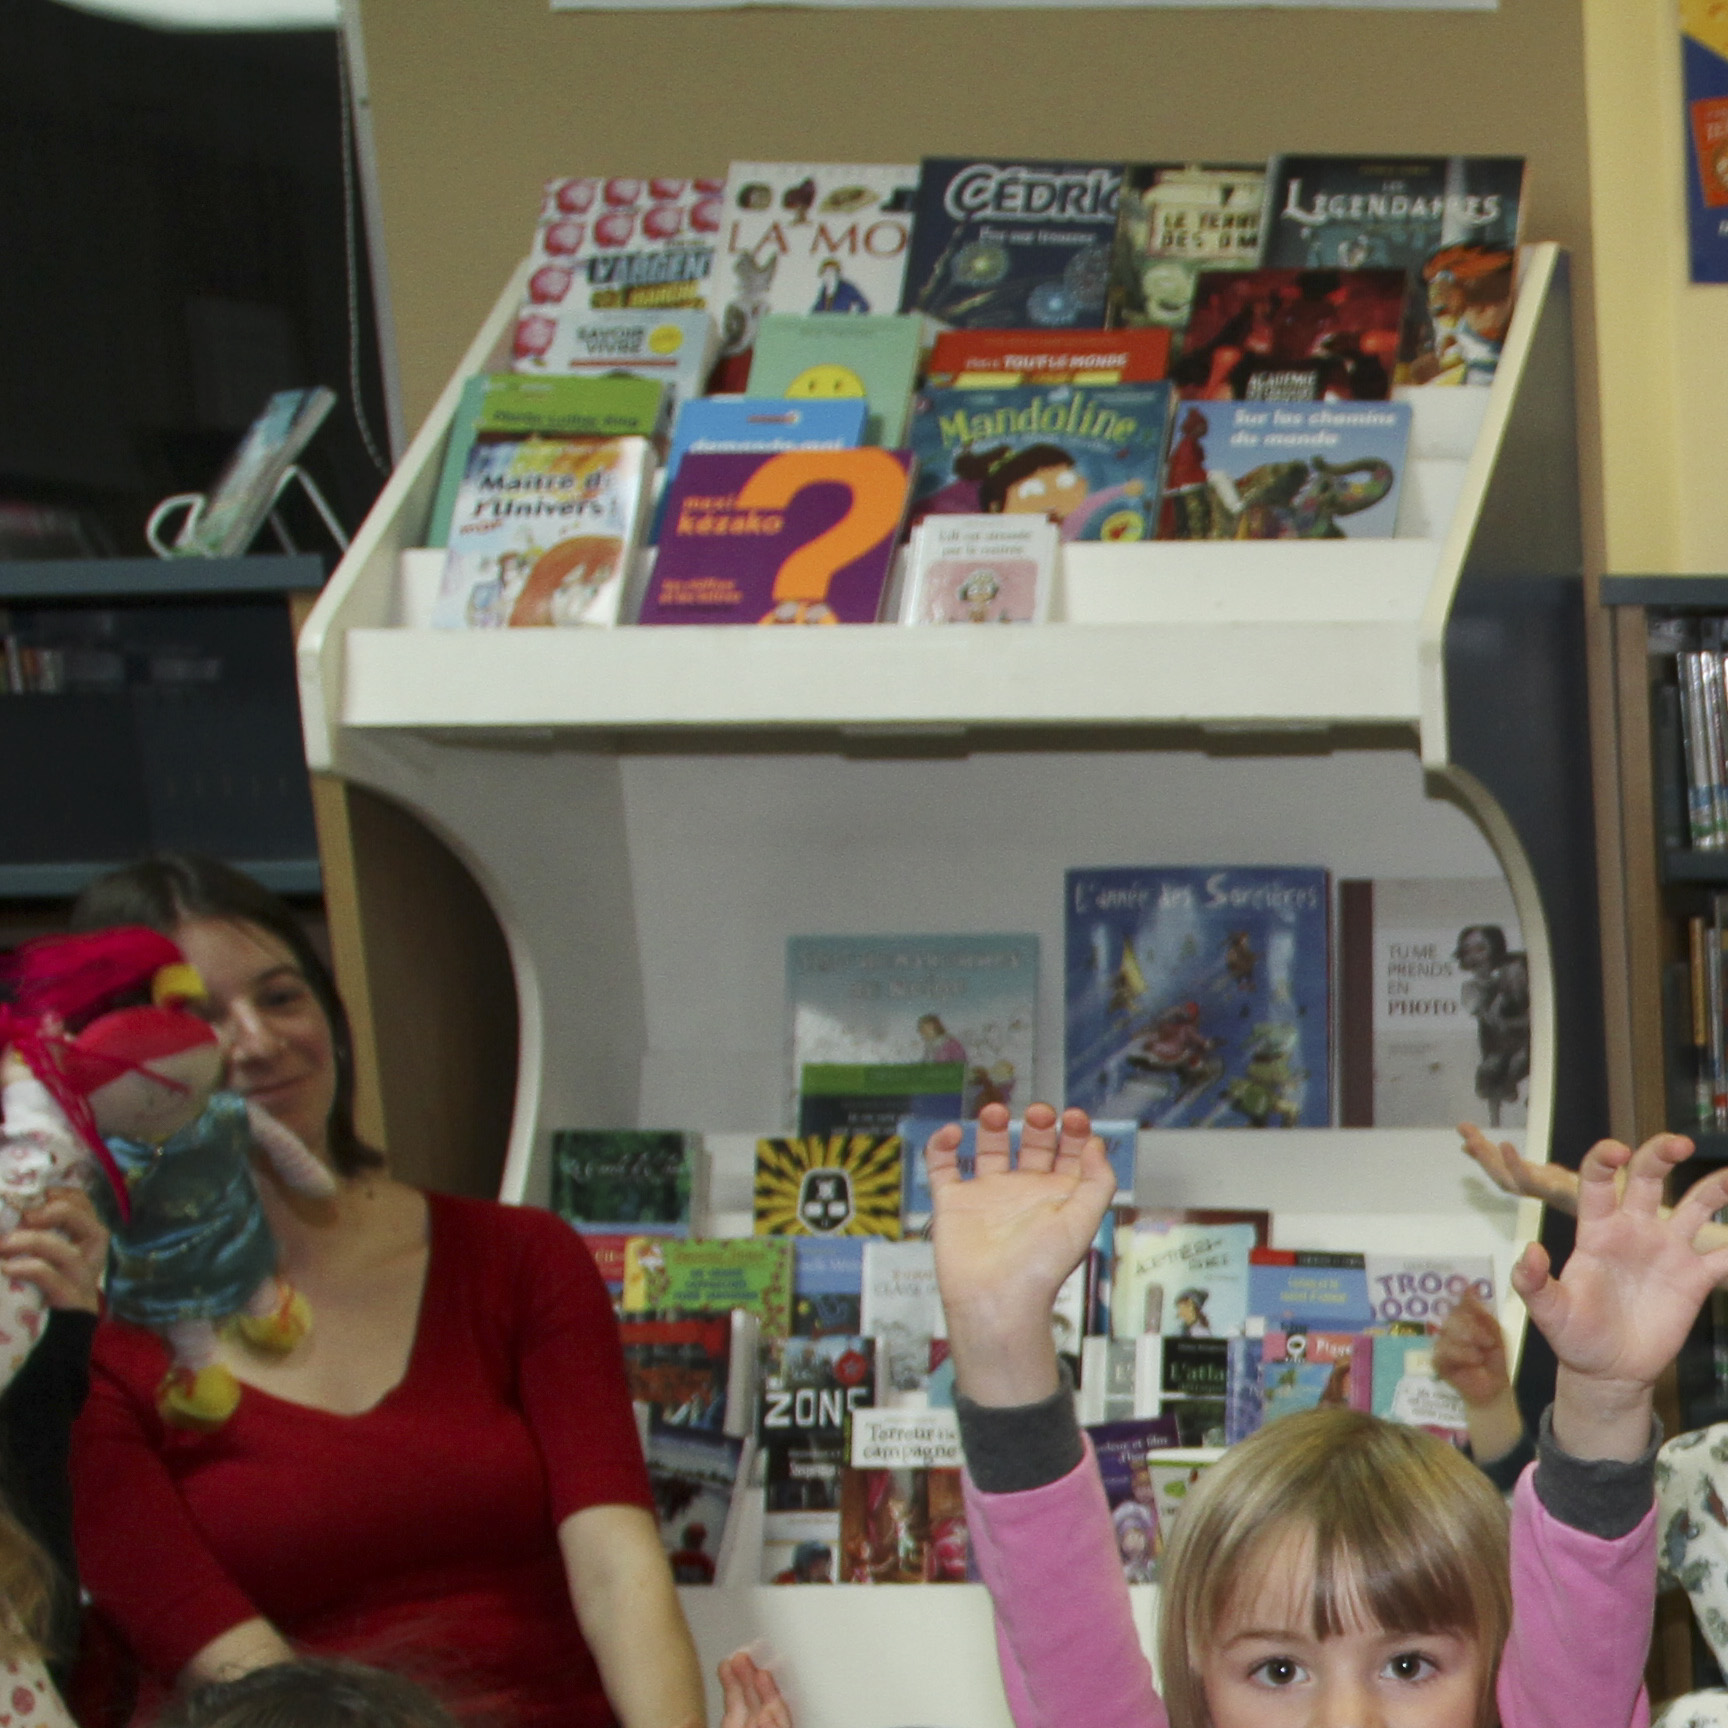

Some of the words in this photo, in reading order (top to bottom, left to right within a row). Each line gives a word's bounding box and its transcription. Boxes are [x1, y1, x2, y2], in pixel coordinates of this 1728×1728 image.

[728, 220, 788, 253] LA
[938, 390, 1138, 449] Mandoline
[1388, 960, 1453, 978] PRENDS
[1388, 999, 1459, 1016] PHOTO
